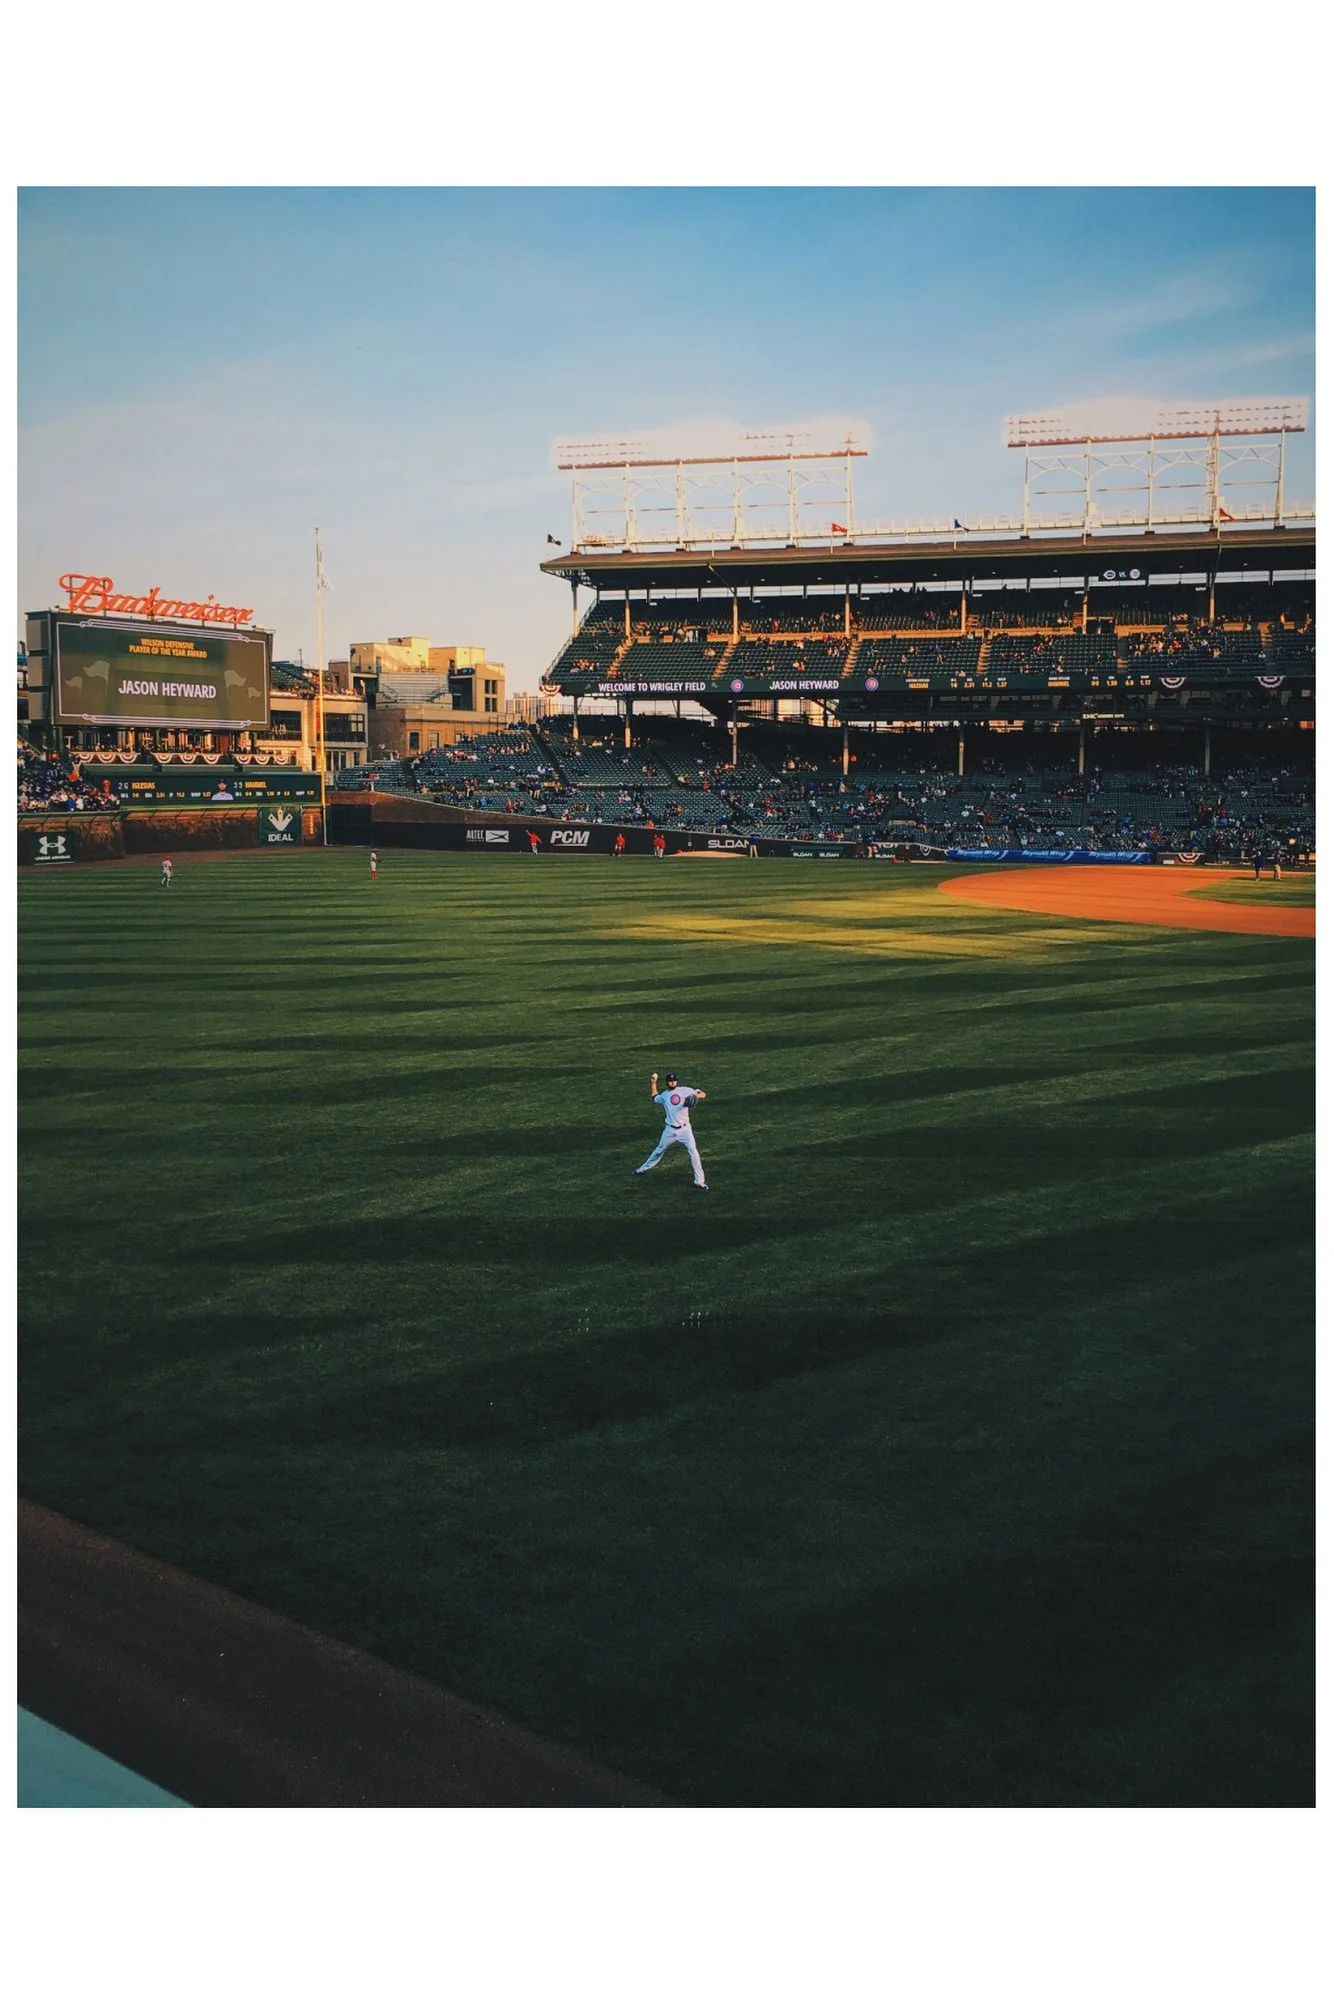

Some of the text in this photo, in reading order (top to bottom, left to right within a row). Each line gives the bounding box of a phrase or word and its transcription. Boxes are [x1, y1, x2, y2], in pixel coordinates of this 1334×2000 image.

[58, 573, 254, 624] Budweiser
[140, 638, 195, 650] WILSON DEFENSIVE
[129, 645, 208, 659] PLAYER OF THE YEAR AWARD
[119, 680, 216, 698] JASON HEYWARD
[598, 682, 706, 692] WELCOME TO WRIGLEY FIELD
[769, 680, 839, 690] JASON HEYWARD
[267, 834, 294, 842] IDEAL
[550, 830, 590, 844] PCM
